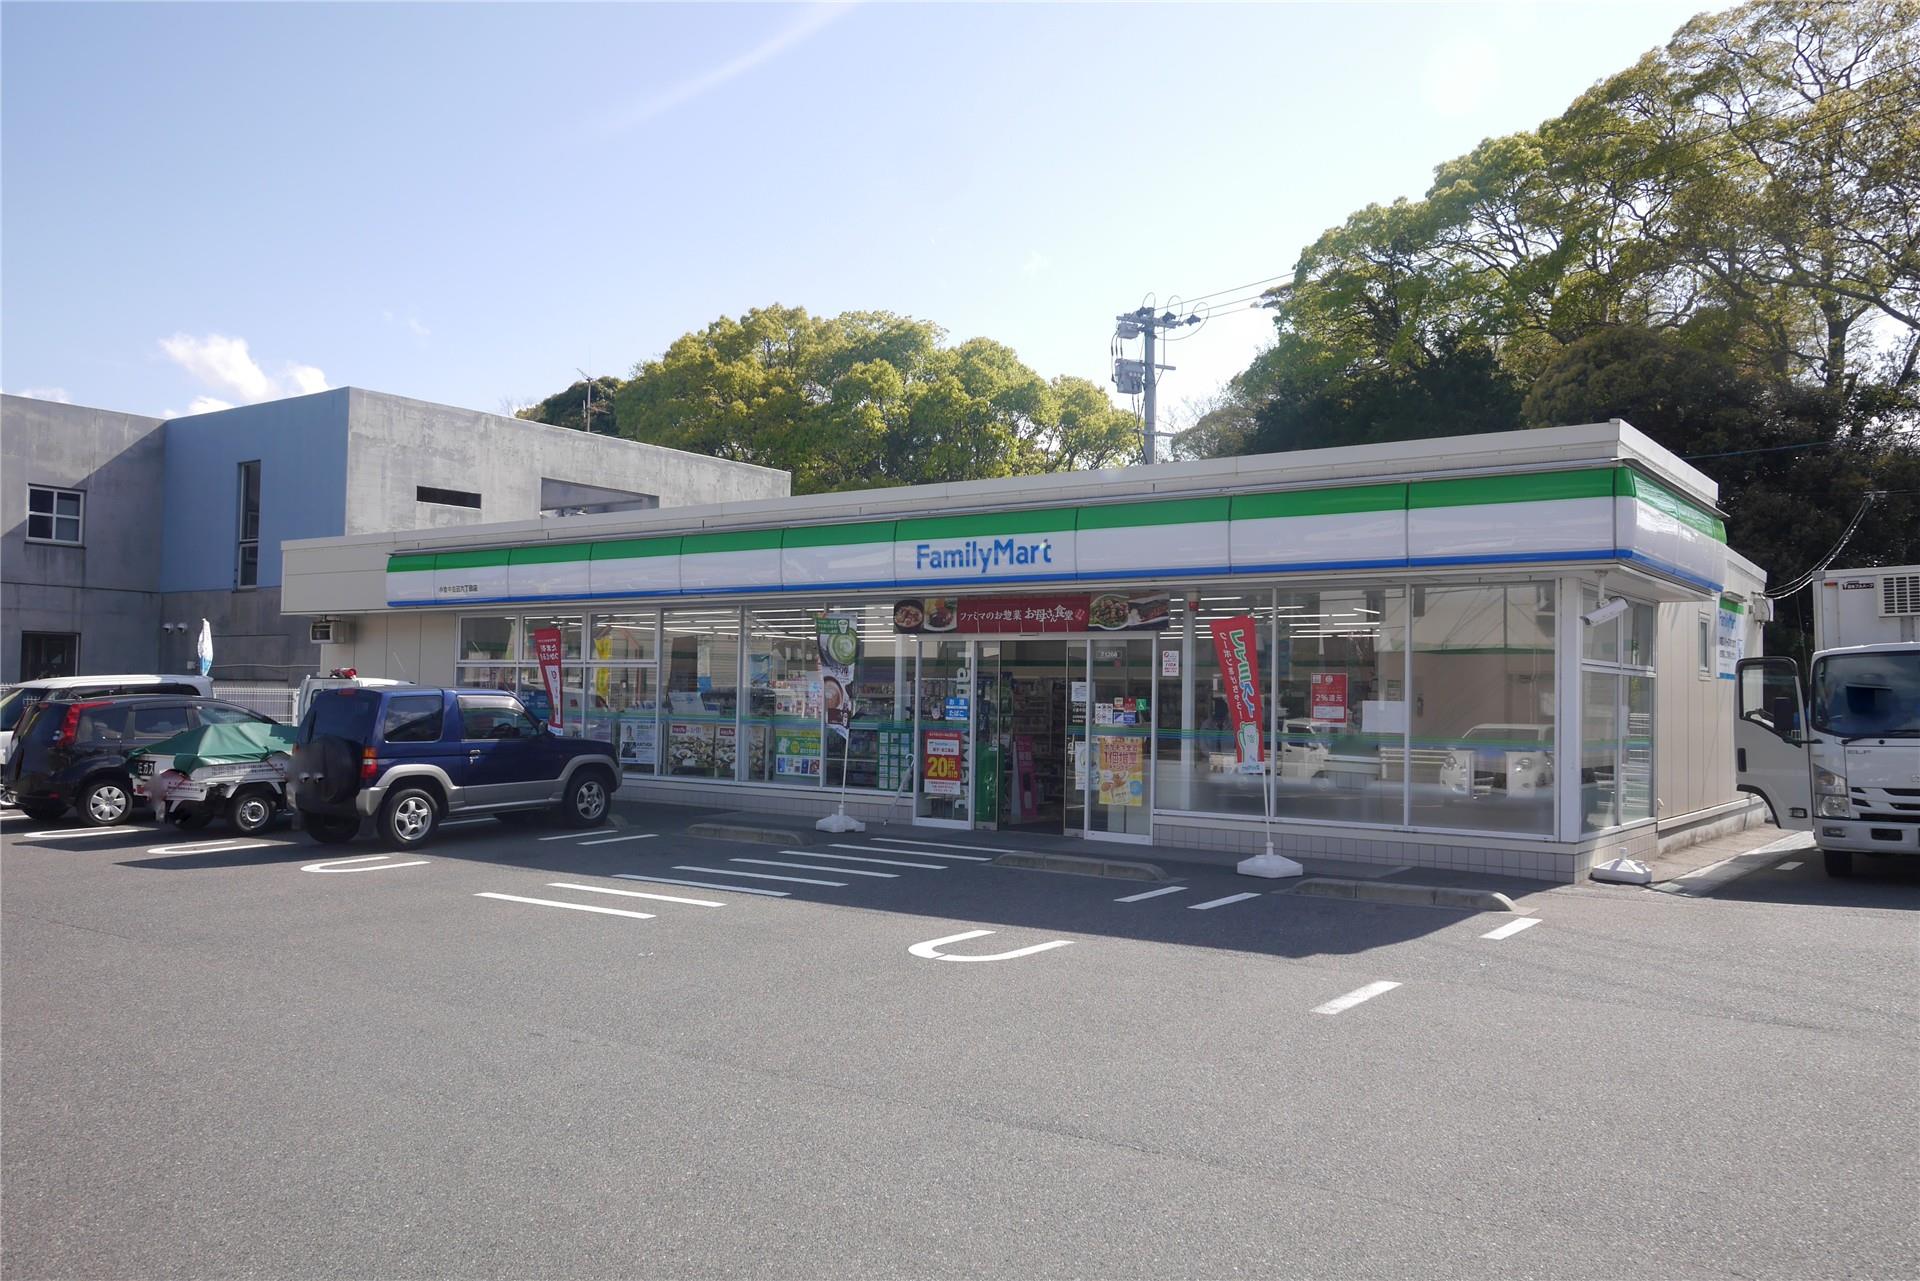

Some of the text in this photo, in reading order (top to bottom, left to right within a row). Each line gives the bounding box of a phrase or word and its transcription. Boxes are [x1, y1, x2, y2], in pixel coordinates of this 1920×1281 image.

[916, 538, 1052, 574] FamilyMart
[960, 604, 1074, 622] ファミマのお惣菜 お母さん食堂
[1315, 694, 1344, 702] 2%還元
[949, 709, 965, 717] たばこ
